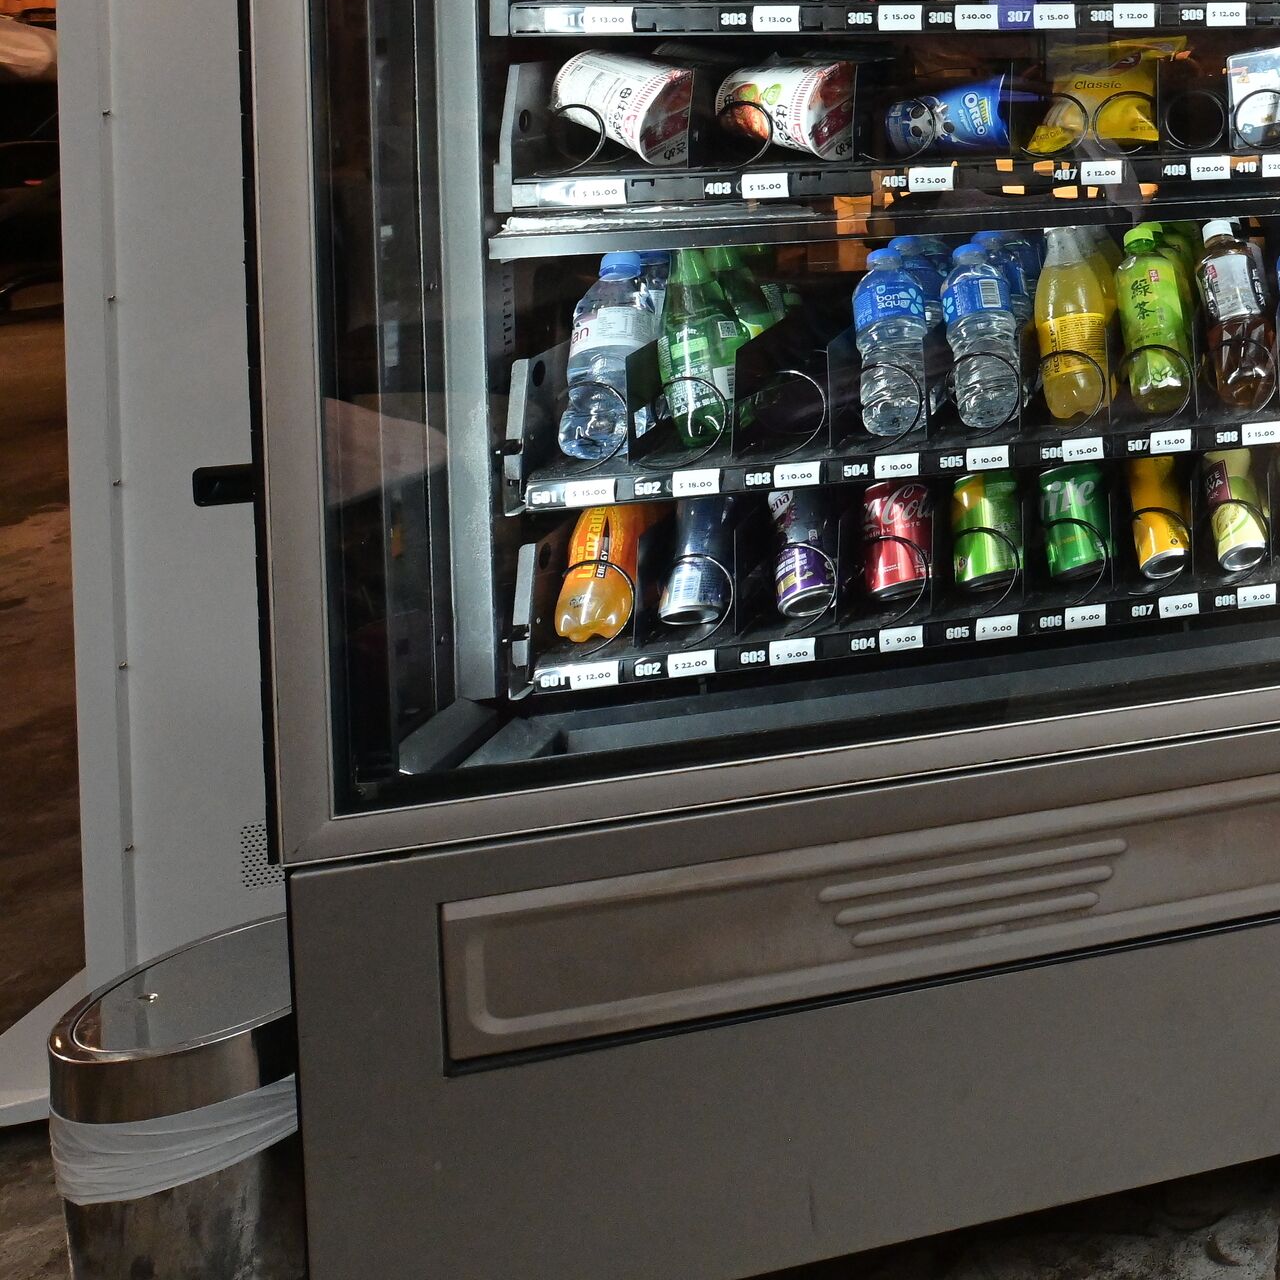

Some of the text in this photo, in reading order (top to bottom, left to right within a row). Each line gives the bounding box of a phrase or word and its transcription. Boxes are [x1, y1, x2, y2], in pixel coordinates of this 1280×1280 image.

[720, 13, 747, 26] 303
[847, 12, 872, 24] 305
[928, 12, 953, 24] 306
[1007, 10, 1032, 23] 307
[1090, 10, 1113, 22] 308
[1074, 80, 1122, 90] Classic
[963, 93, 987, 136] OREO
[1054, 169, 1078, 181] 407
[704, 182, 731, 195] 403
[881, 176, 908, 188] 405
[876, 293, 900, 303] bon
[877, 300, 908, 309] aqua
[1216, 431, 1238, 444] 508
[1127, 439, 1149, 452] 507
[1041, 447, 1063, 460] 506
[939, 456, 963, 469] 505
[843, 464, 868, 477] 504
[745, 472, 771, 486] 503
[634, 481, 661, 495] 502
[531, 489, 558, 505] 501
[1215, 594, 1236, 607] 608
[1131, 604, 1153, 617] 607
[1039, 615, 1062, 628] 606
[945, 626, 970, 639] 605
[851, 637, 875, 651] 604
[740, 651, 766, 664] 603
[634, 662, 661, 677] 602
[540, 675, 566, 688] 601
